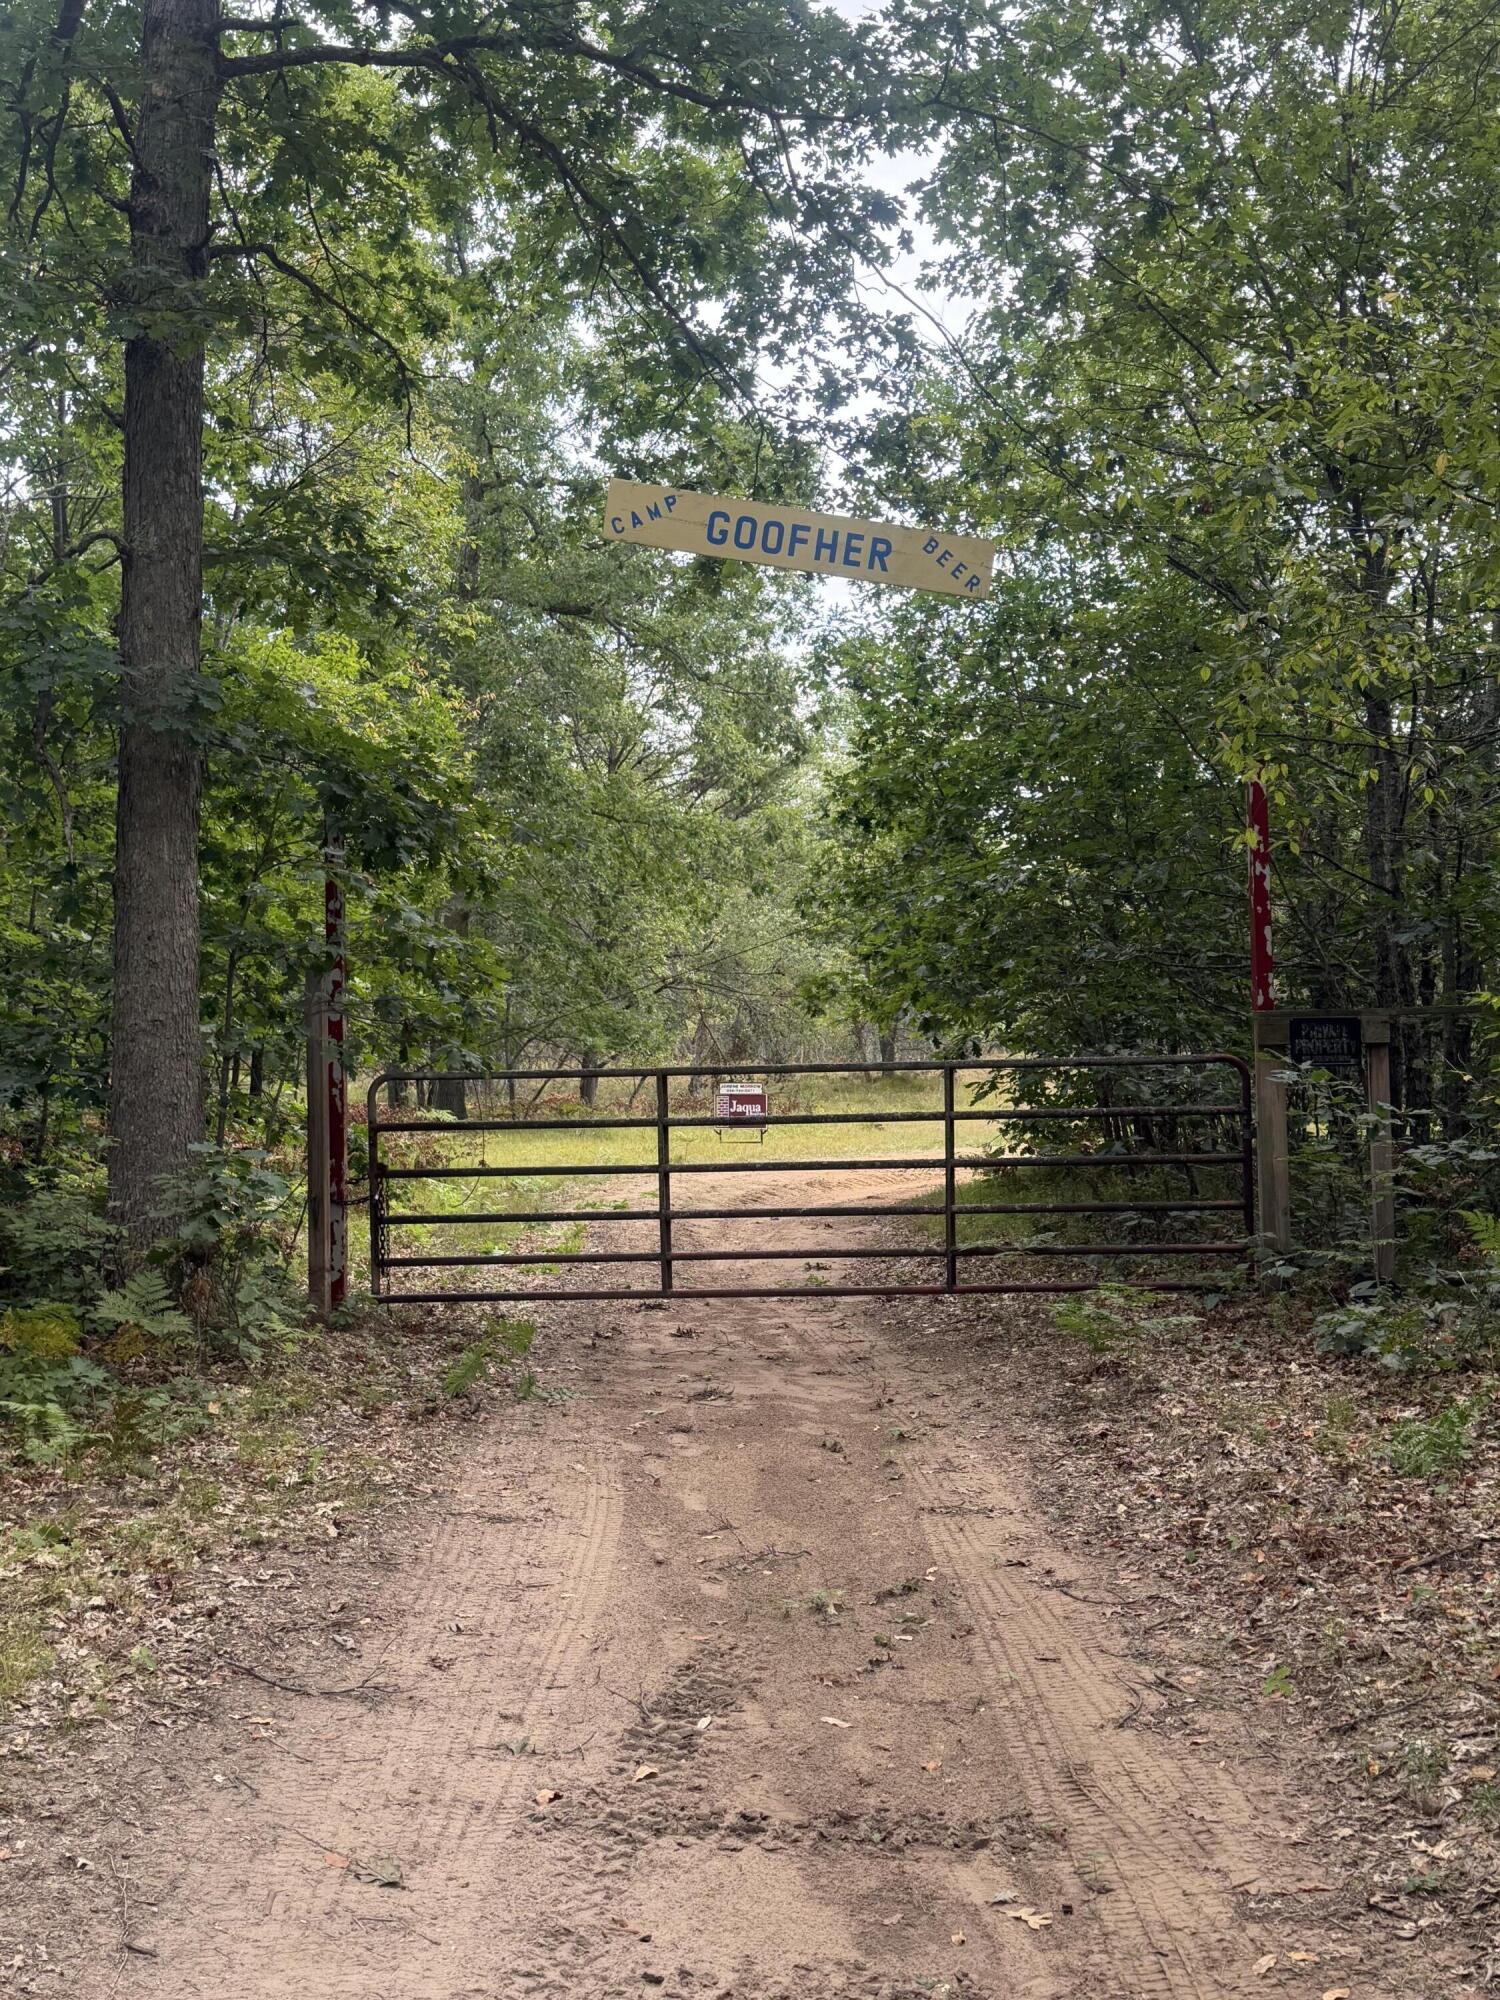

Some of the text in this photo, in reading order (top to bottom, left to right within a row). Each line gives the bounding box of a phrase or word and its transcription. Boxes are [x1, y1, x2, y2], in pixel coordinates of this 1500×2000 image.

[610, 494, 982, 591] CAMP GOOFHER BEER
[1295, 1038, 1356, 1055] PROPERTY
[730, 1100, 761, 1116] Jaqua
